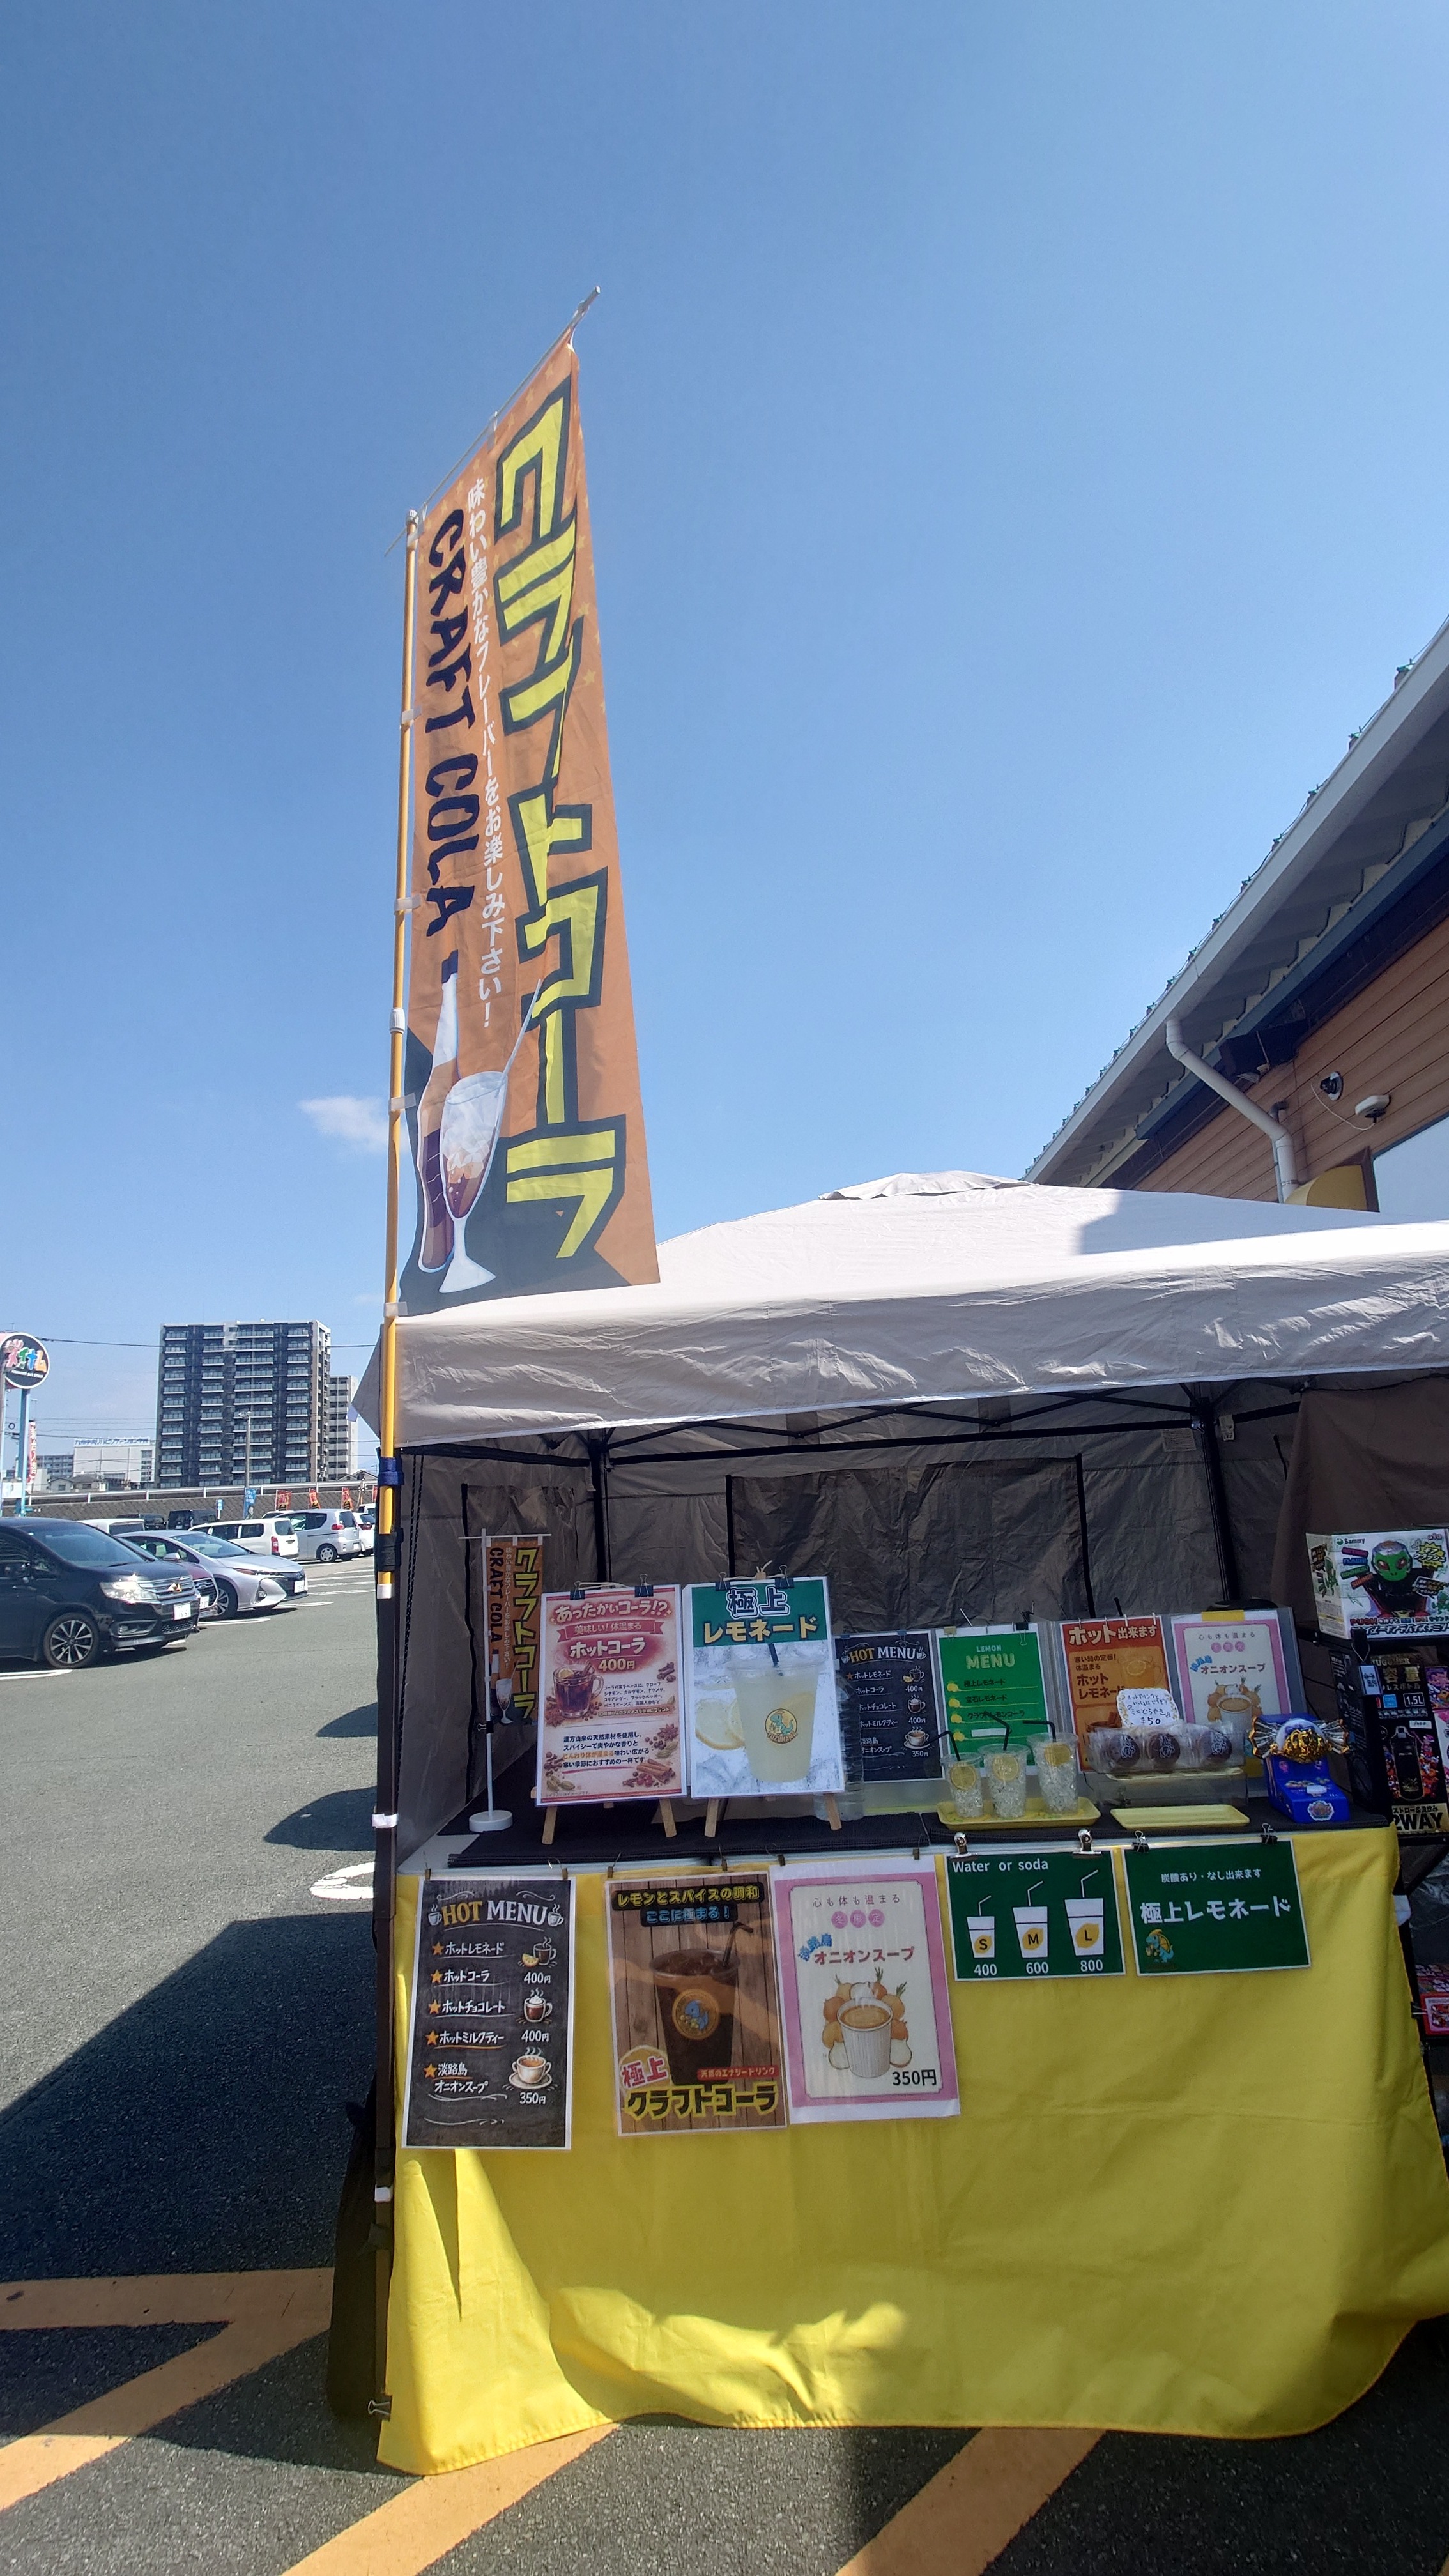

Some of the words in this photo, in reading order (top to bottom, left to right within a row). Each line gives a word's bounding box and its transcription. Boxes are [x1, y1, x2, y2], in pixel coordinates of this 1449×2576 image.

[425, 509, 475, 734] CRAFT
[494, 377, 624, 1260] クラフトコーラ
[426, 754, 481, 937] COLA
[489, 1547, 504, 1598] CRAFT
[727, 1586, 790, 1618] 極上
[489, 1602, 503, 1643] COLA
[513, 1547, 539, 1719] クラフトコーラ
[703, 1616, 817, 1644] レモネード
[569, 1636, 647, 1659] ホットコーラ
[976, 1644, 1002, 1653] LEMON
[848, 1647, 875, 1664] HOT
[877, 1646, 916, 1660] MENU
[965, 1653, 1015, 1669] MENU
[599, 1659, 635, 1672] 400円
[1075, 1663, 1101, 1672] 体温まる
[1200, 1663, 1266, 1675] オニオンスープ
[854, 1669, 891, 1679] ホットレモネード
[1077, 1672, 1109, 1687] ホット
[964, 1678, 1006, 1687] 極上レモネード
[856, 1686, 884, 1694] ホットコーラ
[1406, 1695, 1423, 1705] 1.5L
[968, 1710, 1025, 1719] クラフトモンコーラ
[953, 1859, 990, 1873] Water
[998, 1861, 1013, 1870] or
[1018, 1858, 1049, 1872] soda
[617, 1885, 760, 1907] レモンとスパイスの調和
[813, 1894, 901, 1908] 心も体も温まる
[441, 1900, 483, 1927] HOT
[486, 1899, 549, 1926] MENU
[1140, 1896, 1291, 1924] 極上レモネード
[1027, 1933, 1039, 1945] M
[1084, 1929, 1092, 1942] L
[445, 1942, 505, 1956] ホットレモネード
[979, 1938, 988, 1950] S
[814, 1946, 916, 1966] オニオンスープ
[974, 1963, 997, 1976] 400
[1025, 1961, 1049, 1975] 600
[1080, 1959, 1103, 1972] 800
[443, 1970, 490, 1982] ホットコーラ
[524, 1972, 551, 1984] 400円
[441, 2000, 506, 2014] ホットチョコレート
[439, 2031, 505, 2045] ホットミルクティー
[521, 2030, 549, 2043] 400円
[437, 2063, 468, 2076] 淡路島
[621, 2056, 668, 2088] 極上
[892, 2069, 937, 2087] 350円
[434, 2081, 489, 2094] オニオンスープ
[519, 2092, 546, 2105] 350円
[626, 2083, 778, 2119] クラフトコーラ
